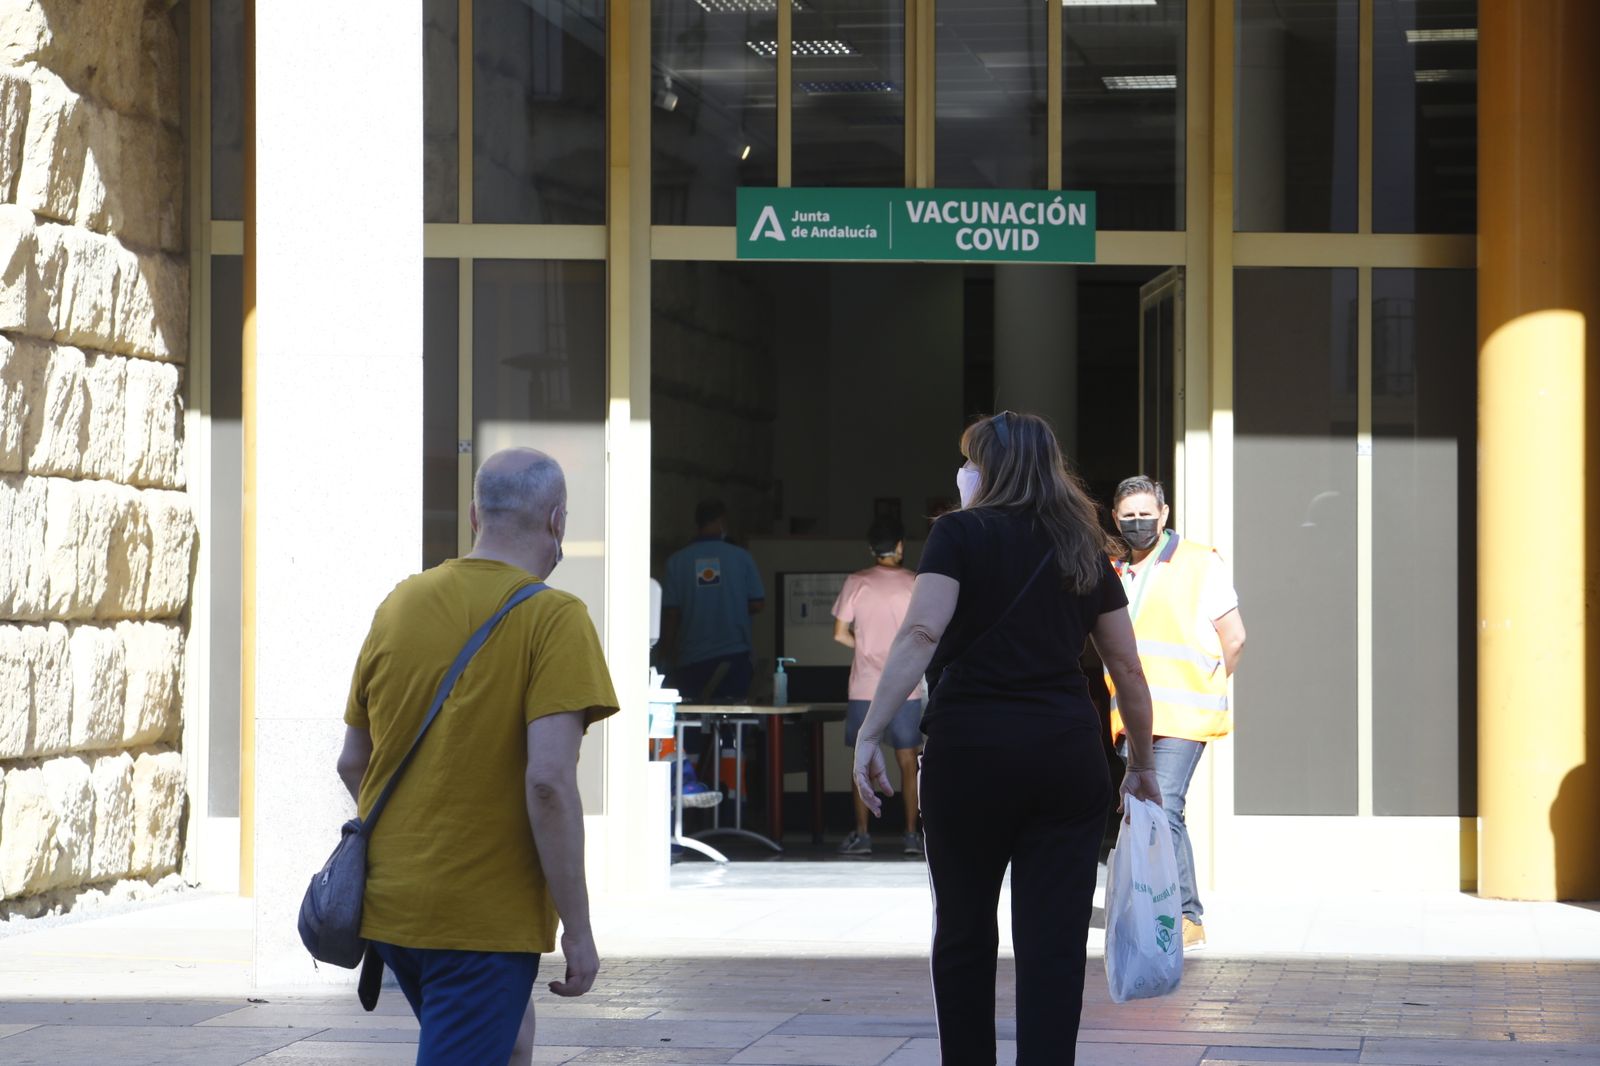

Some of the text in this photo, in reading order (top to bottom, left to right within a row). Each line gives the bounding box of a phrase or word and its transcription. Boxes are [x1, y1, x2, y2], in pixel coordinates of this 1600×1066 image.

[791, 210, 830, 222] Junta
[906, 196, 1087, 226] VACUNACIÓN
[791, 224, 877, 239] de Andalucía
[955, 227, 1040, 252] COVID
